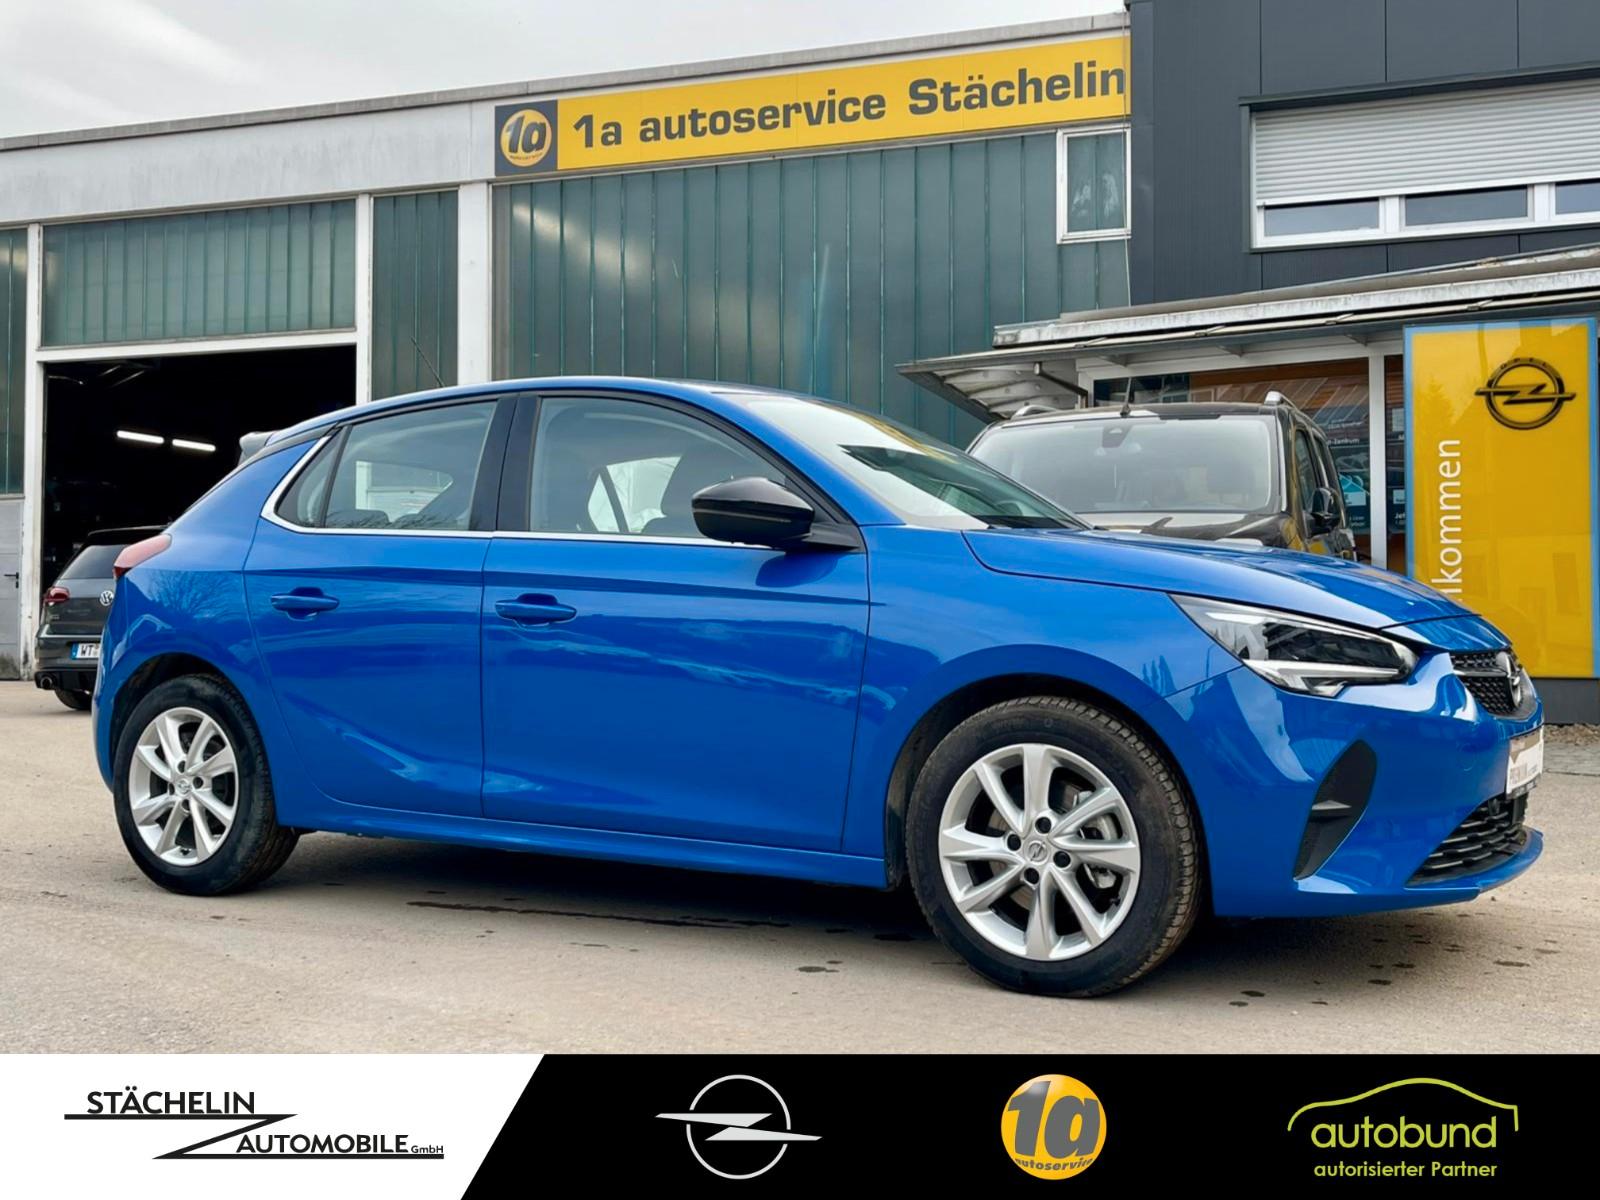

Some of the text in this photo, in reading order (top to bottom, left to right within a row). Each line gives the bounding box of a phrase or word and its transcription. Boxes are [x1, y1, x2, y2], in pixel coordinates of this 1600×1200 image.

[506, 115, 547, 154] 1a
[573, 61, 1125, 148] 1a autoservice Stächelin
[1431, 439, 1463, 600] lkommen
